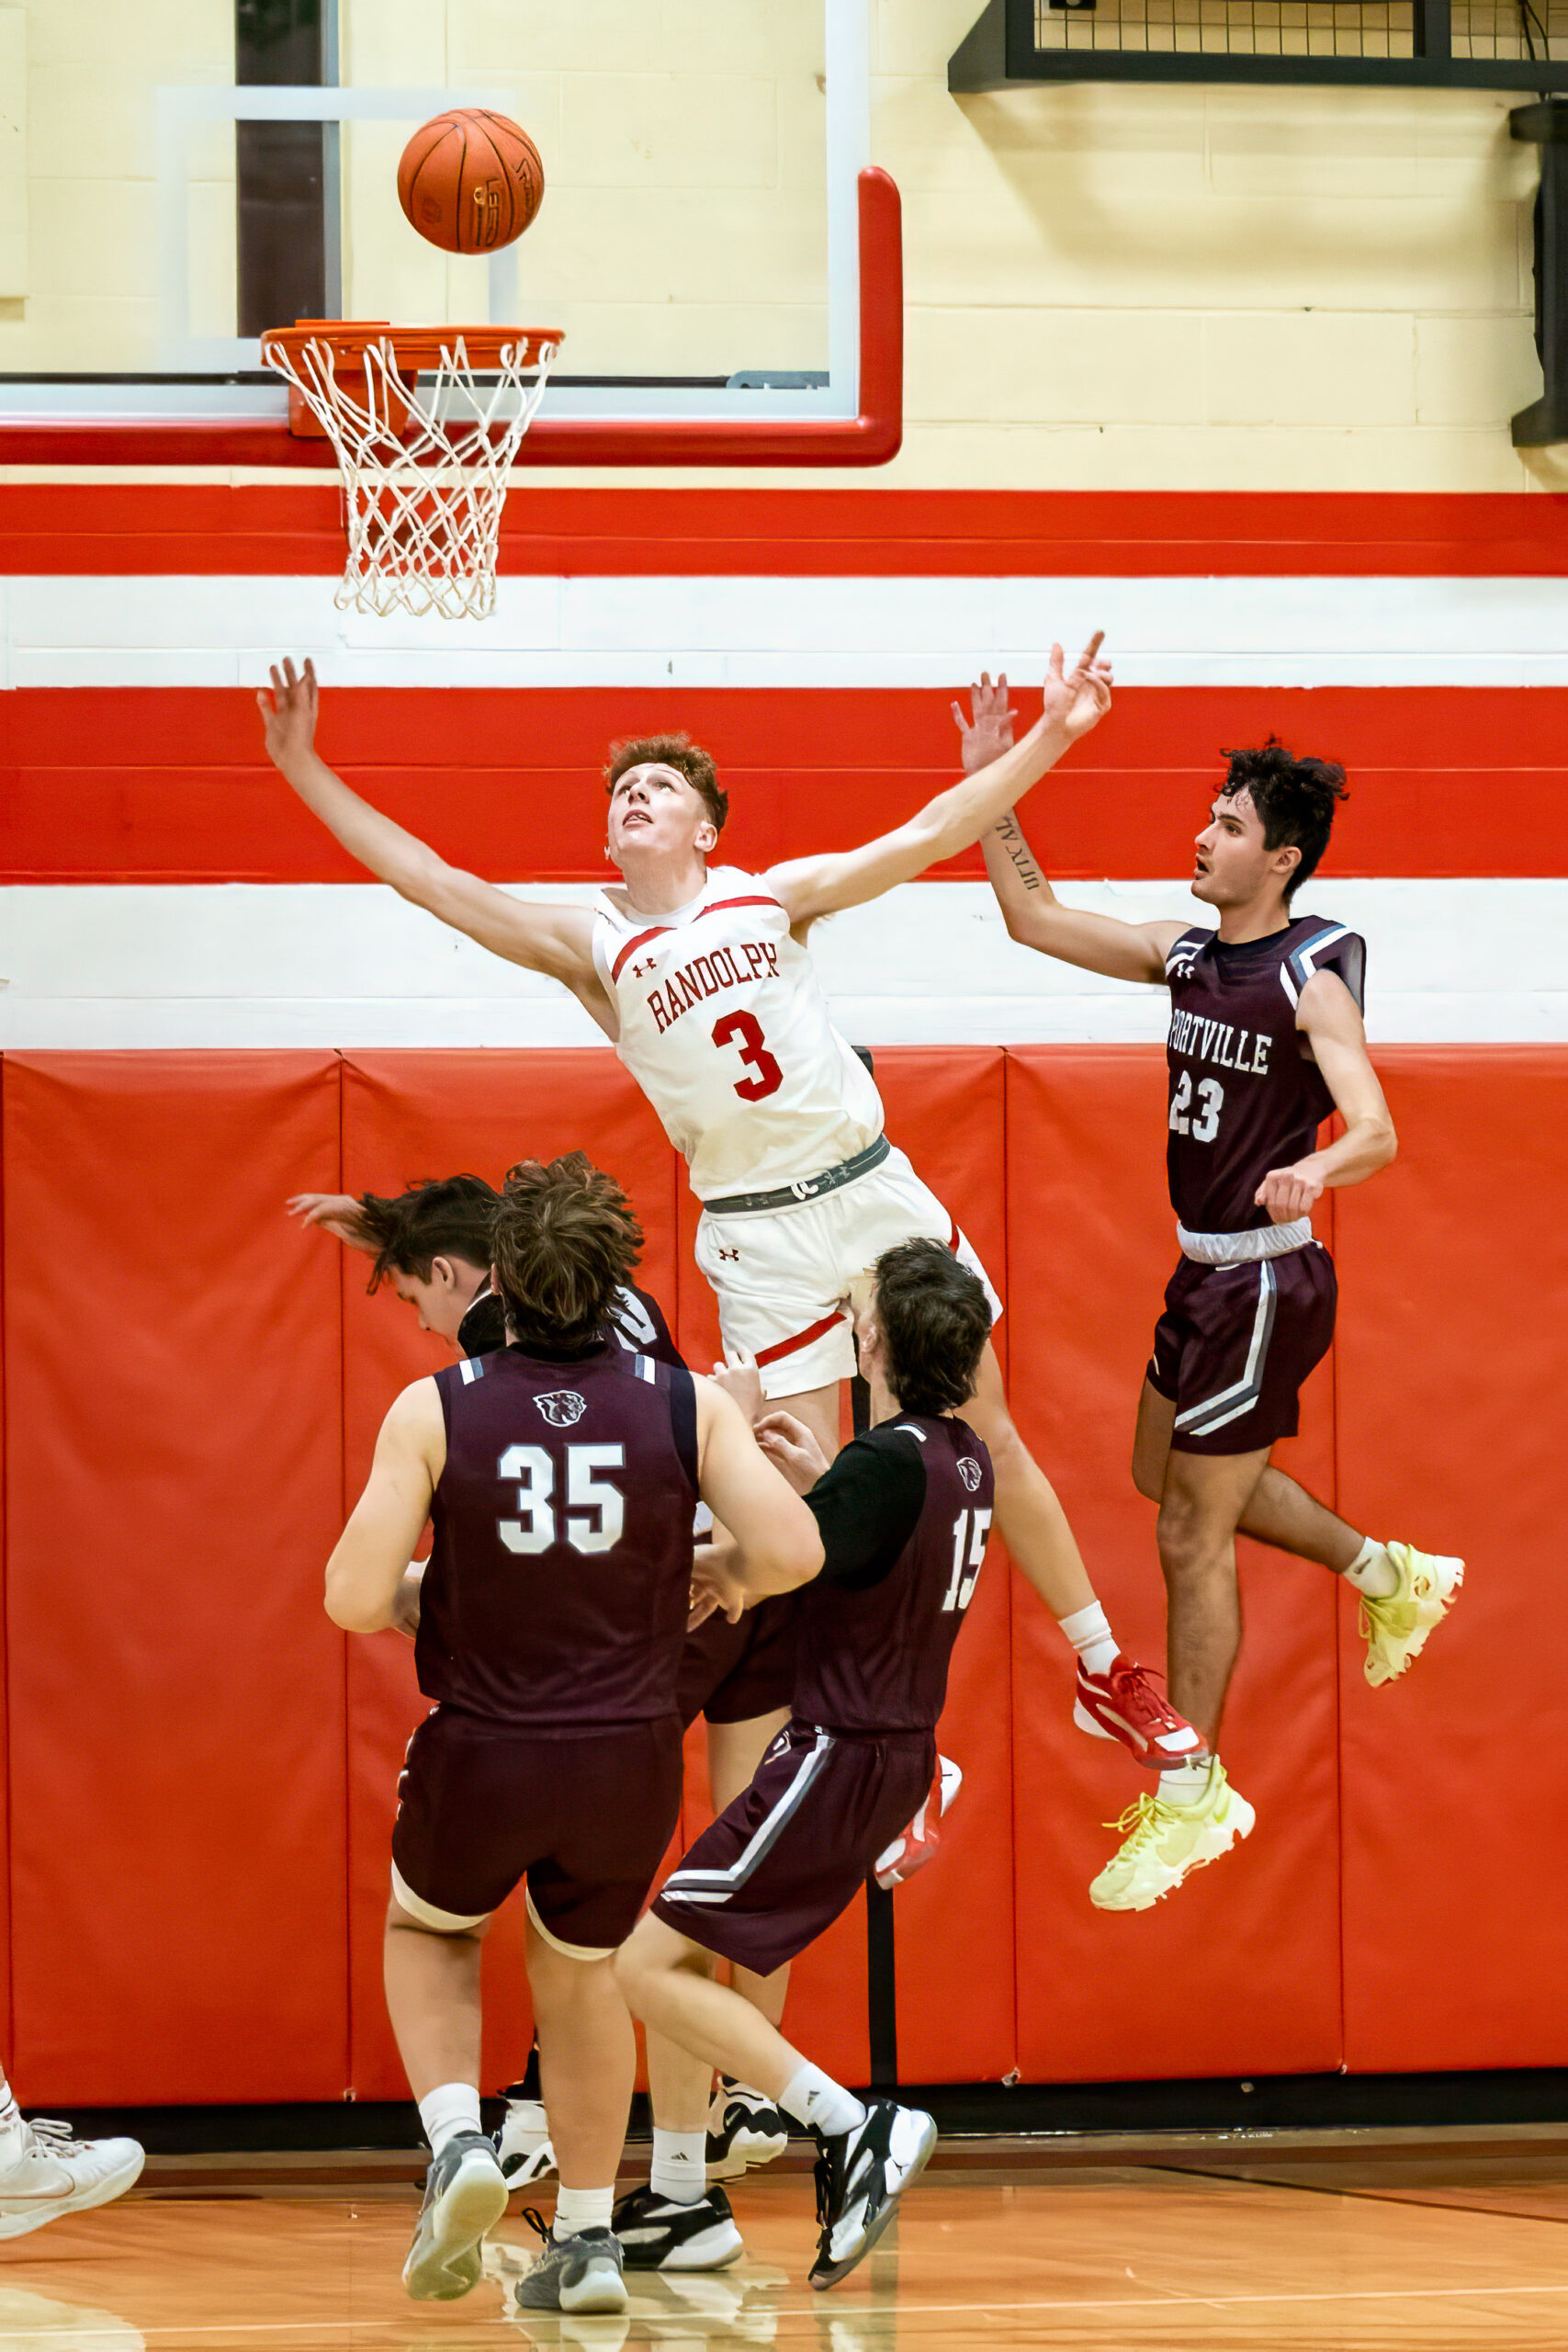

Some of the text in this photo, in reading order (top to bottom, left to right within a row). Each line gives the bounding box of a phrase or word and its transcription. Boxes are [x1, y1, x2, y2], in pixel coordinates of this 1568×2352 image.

[647, 942, 780, 1035] RANDOLPH
[711, 1009, 784, 1102] 3
[1168, 1069, 1224, 1143] 23
[498, 1443, 626, 1554] 35
[942, 1508, 993, 1611] 15
